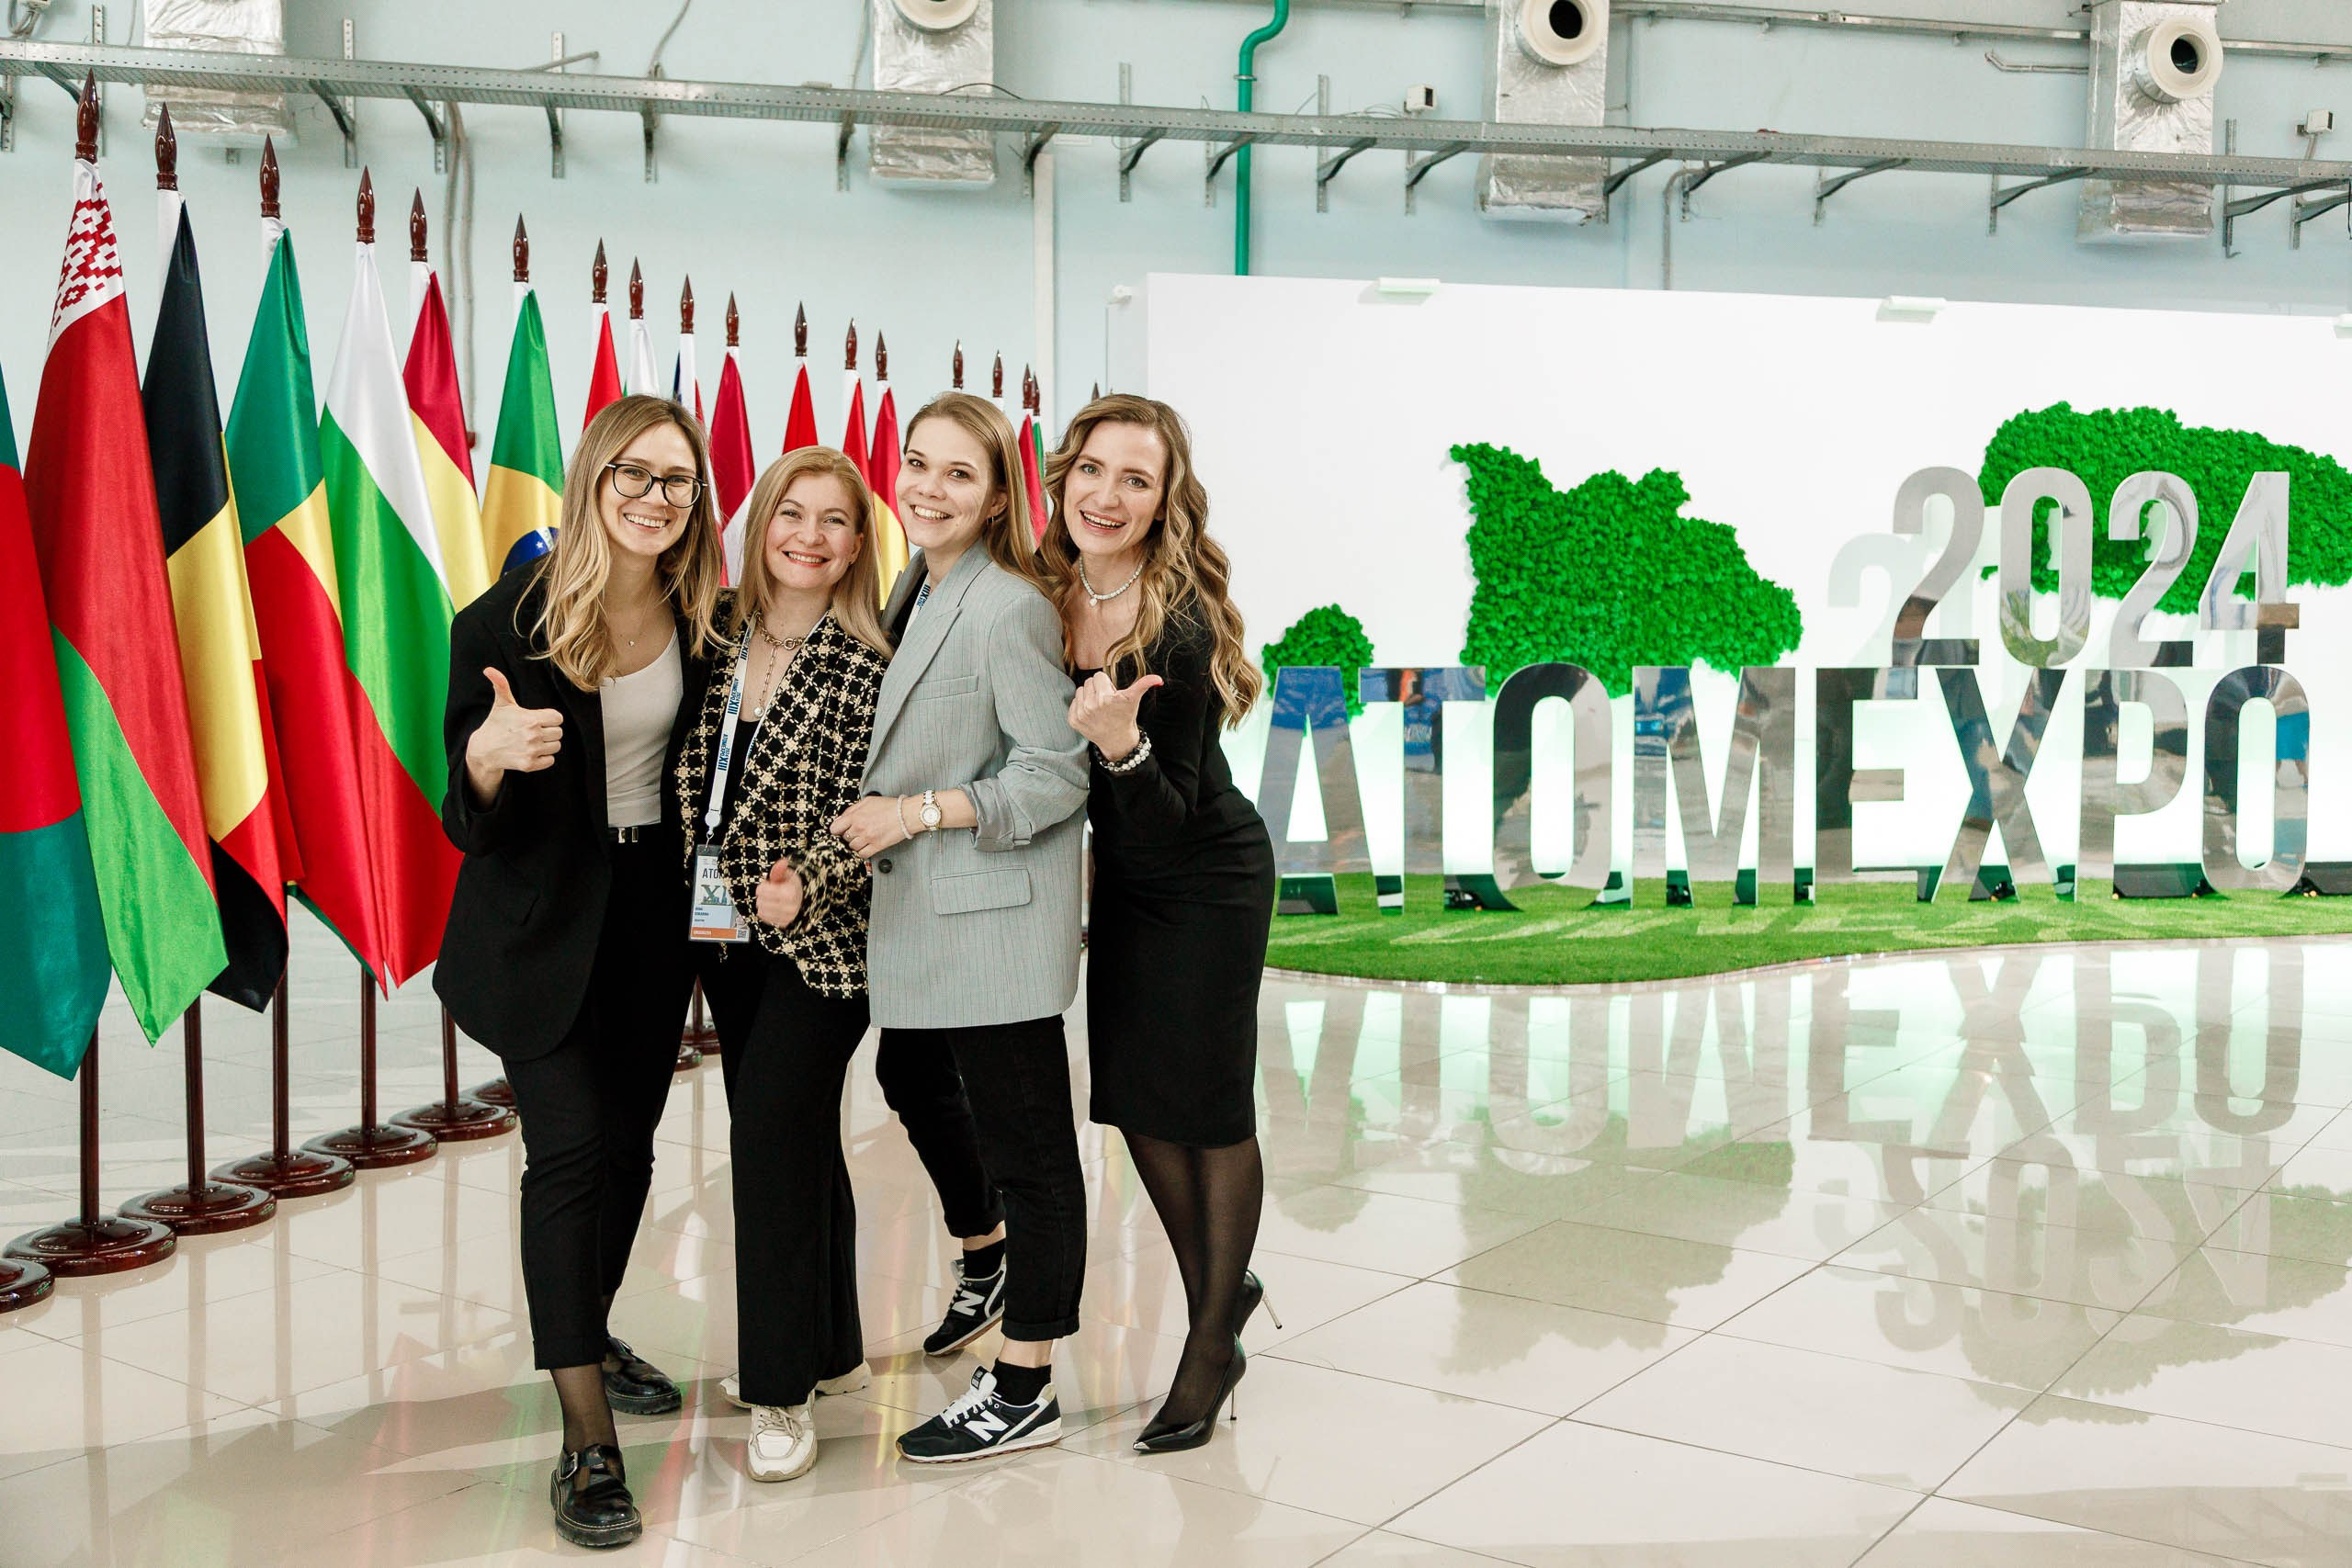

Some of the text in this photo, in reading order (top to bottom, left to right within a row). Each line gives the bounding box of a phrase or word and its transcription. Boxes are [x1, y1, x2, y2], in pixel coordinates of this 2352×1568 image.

[1892, 466, 2300, 669] 2024
[727, 701, 740, 716] XIII
[717, 756, 729, 772] XIII
[1256, 661, 2311, 915] ATOMEXPO
[702, 868, 722, 879] ATO
[964, 1410, 1010, 1442] N
